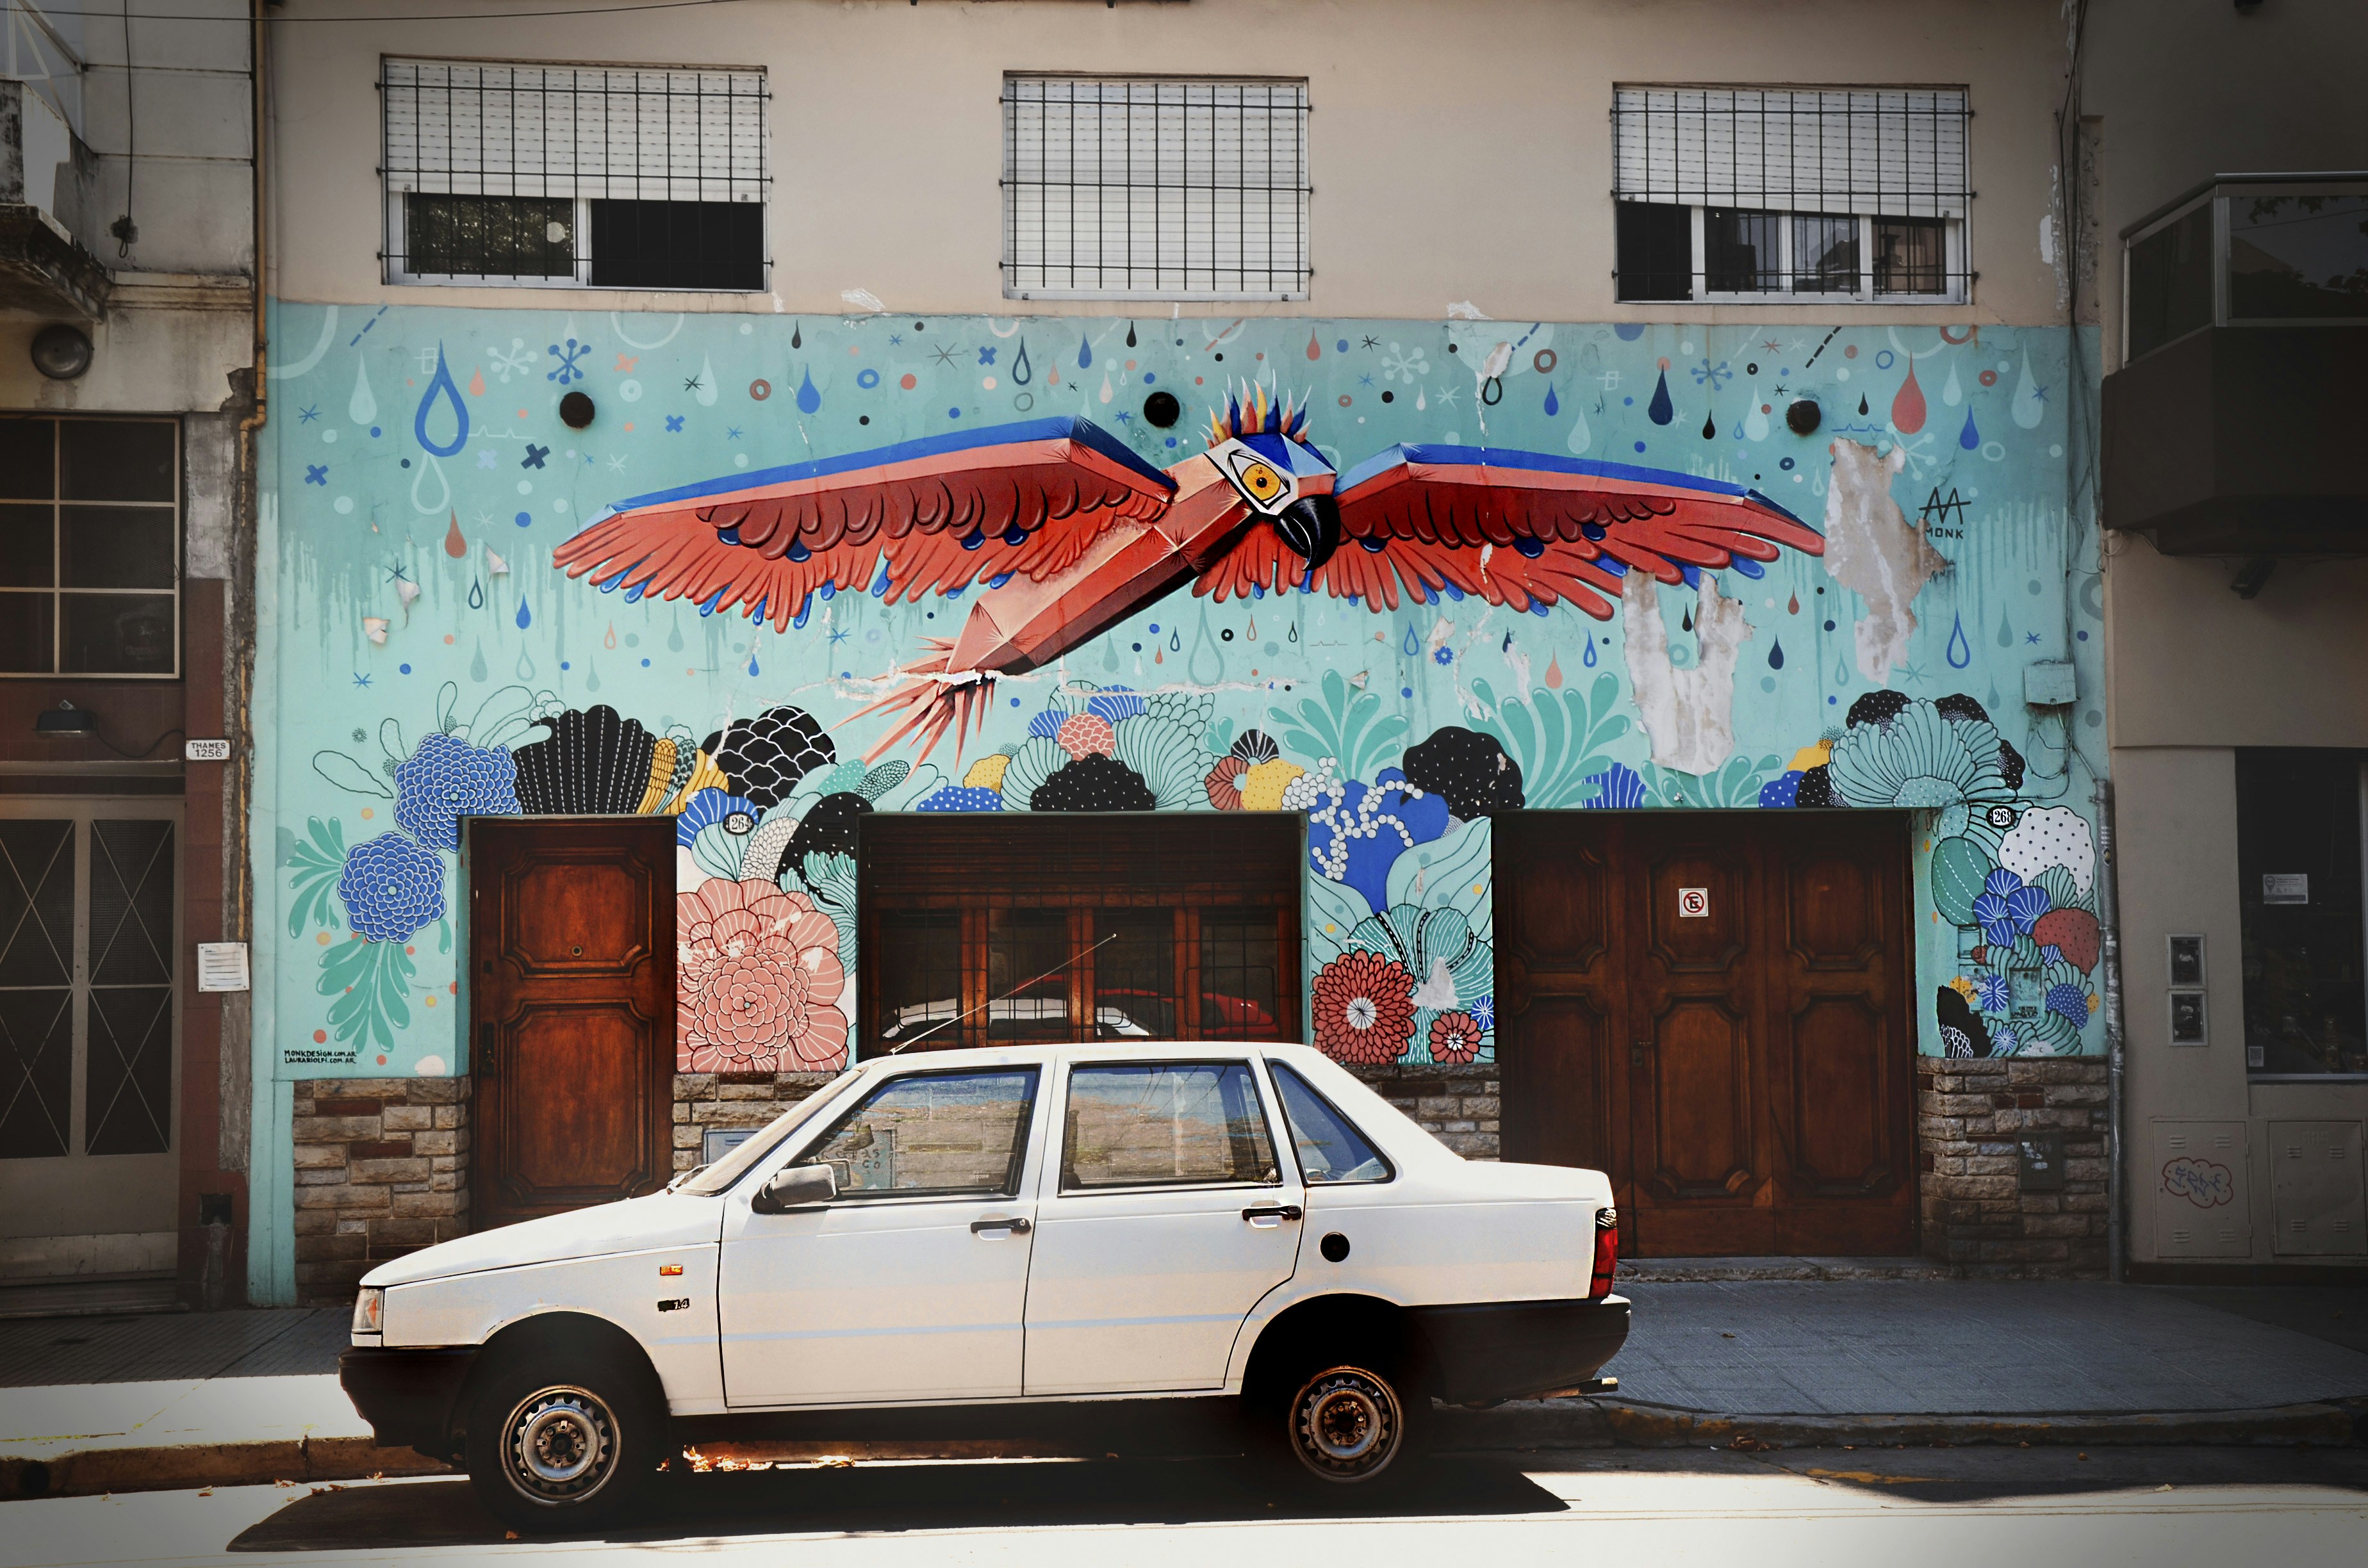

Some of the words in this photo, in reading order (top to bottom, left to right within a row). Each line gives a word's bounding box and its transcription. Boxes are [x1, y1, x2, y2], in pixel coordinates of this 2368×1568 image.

[1925, 527, 1964, 539] MONK
[195, 749, 222, 758] 1256
[673, 1300, 688, 1310] 1.4
